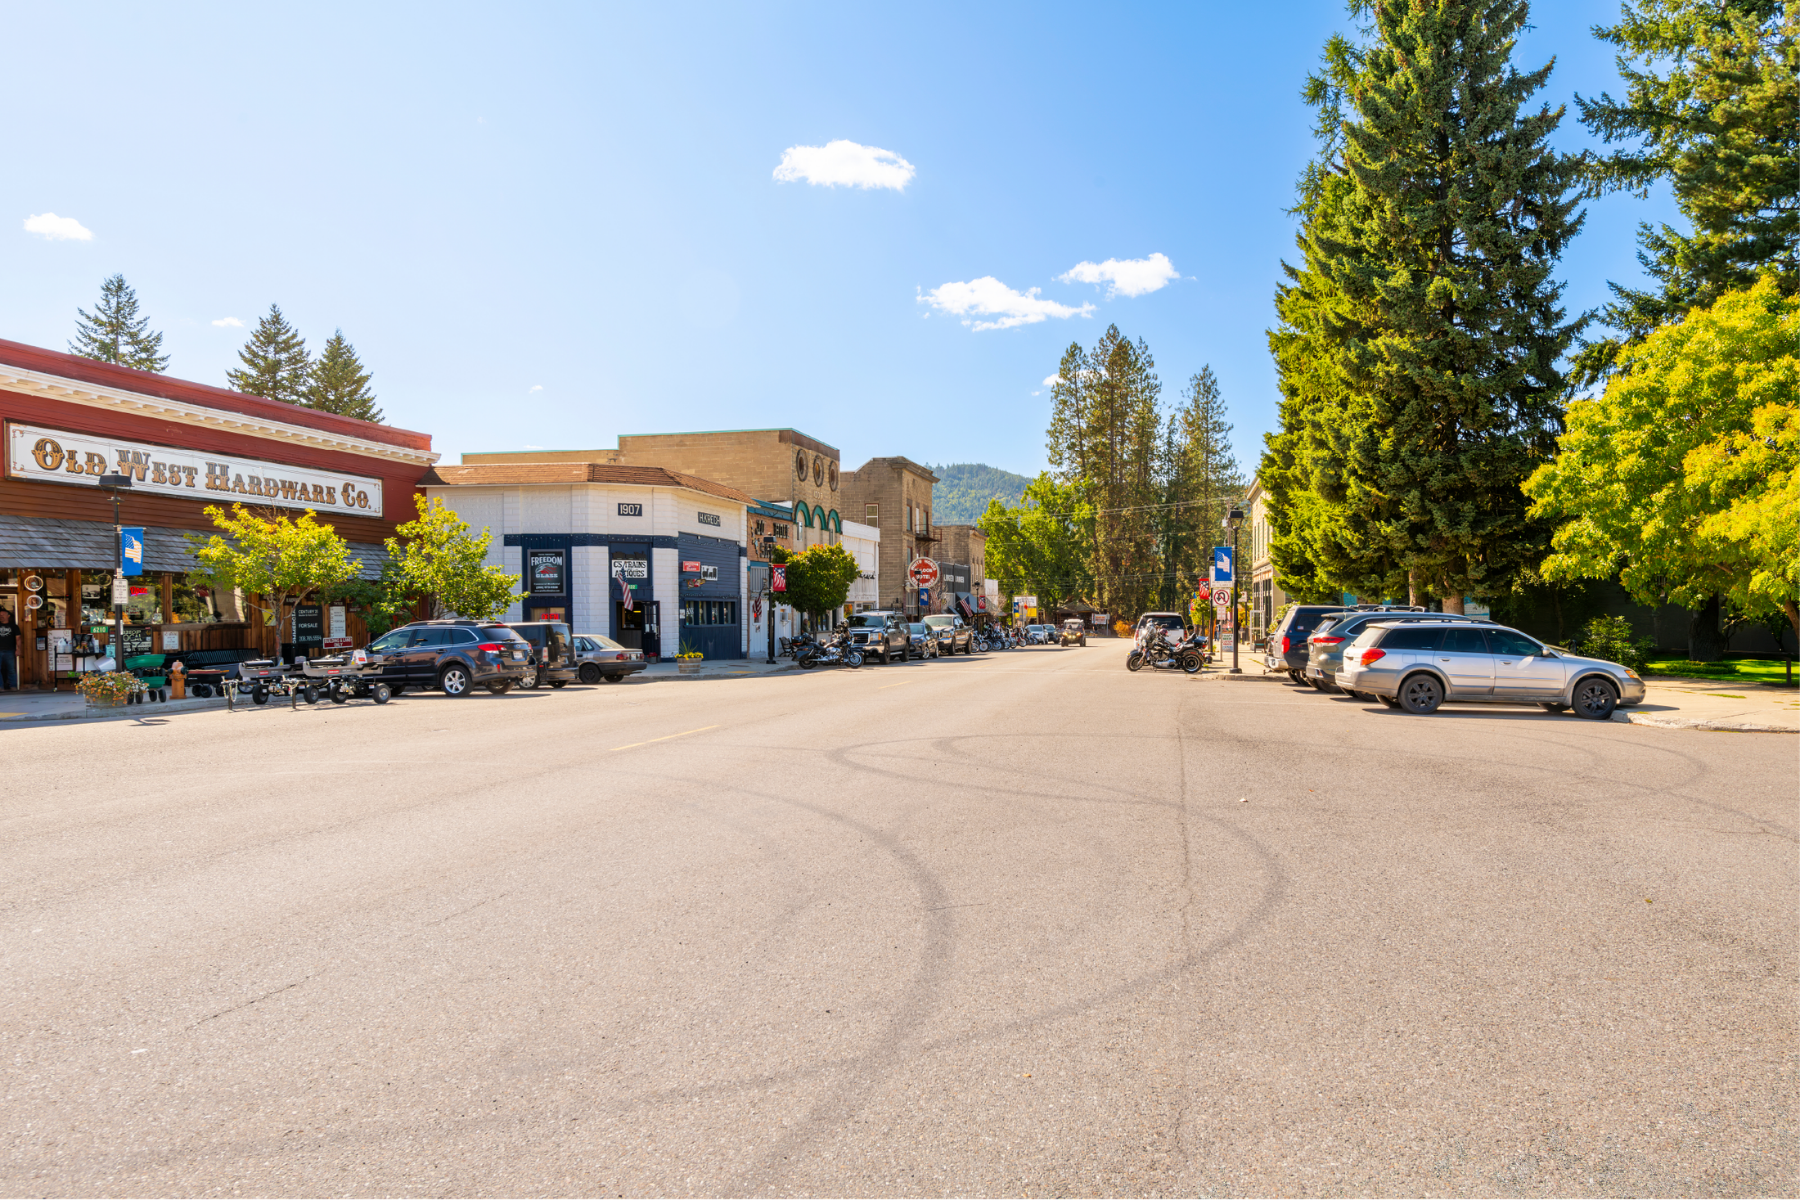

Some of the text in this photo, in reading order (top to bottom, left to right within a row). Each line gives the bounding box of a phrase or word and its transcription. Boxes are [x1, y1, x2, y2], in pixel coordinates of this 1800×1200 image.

[31, 438, 371, 510] OLD WEST HARDWARE CO.
[620, 504, 640, 515] 1907
[531, 556, 562, 566] FREEDOM
[613, 560, 646, 569] CS TRAINS
[615, 569, 645, 577] AIQUES
[130, 586, 148, 596] Open
